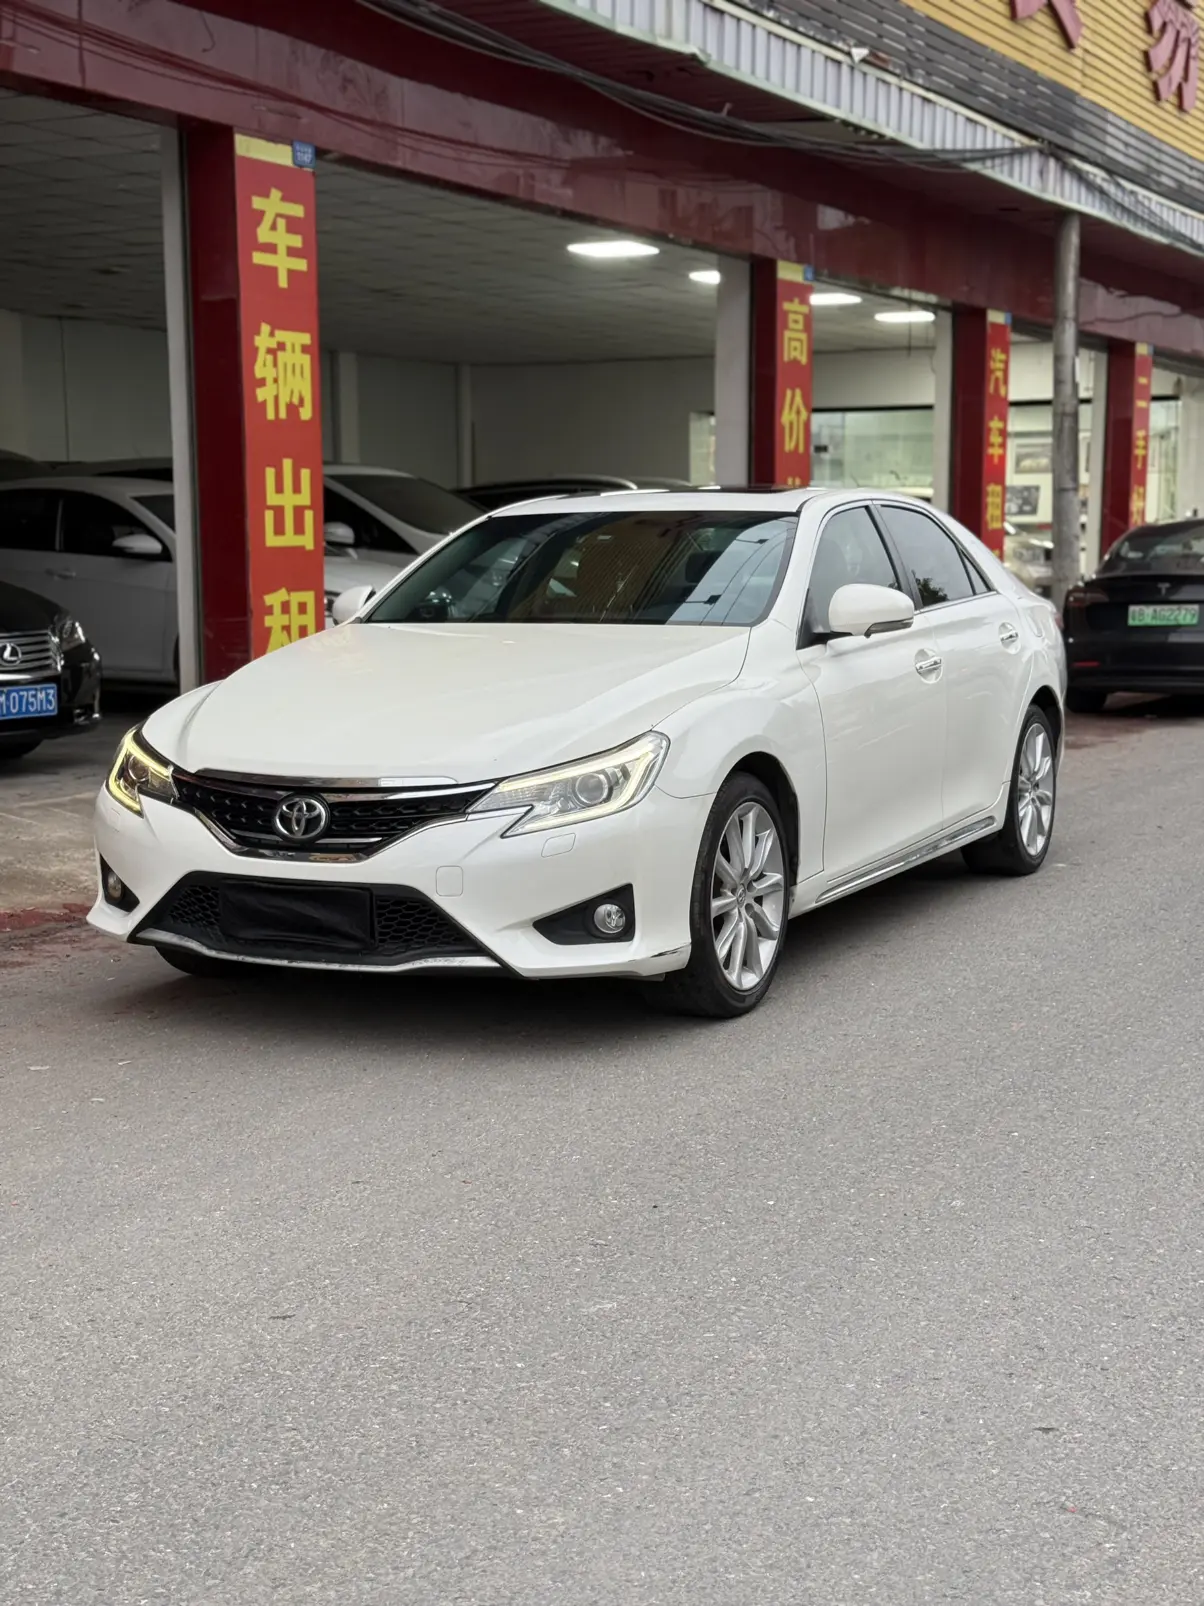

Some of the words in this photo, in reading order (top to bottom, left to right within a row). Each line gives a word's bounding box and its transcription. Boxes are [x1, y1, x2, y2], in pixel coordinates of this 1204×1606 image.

[251, 187, 316, 655] 车辆出租
[781, 297, 810, 486] 高价
[986, 348, 1007, 558] 汽车租
